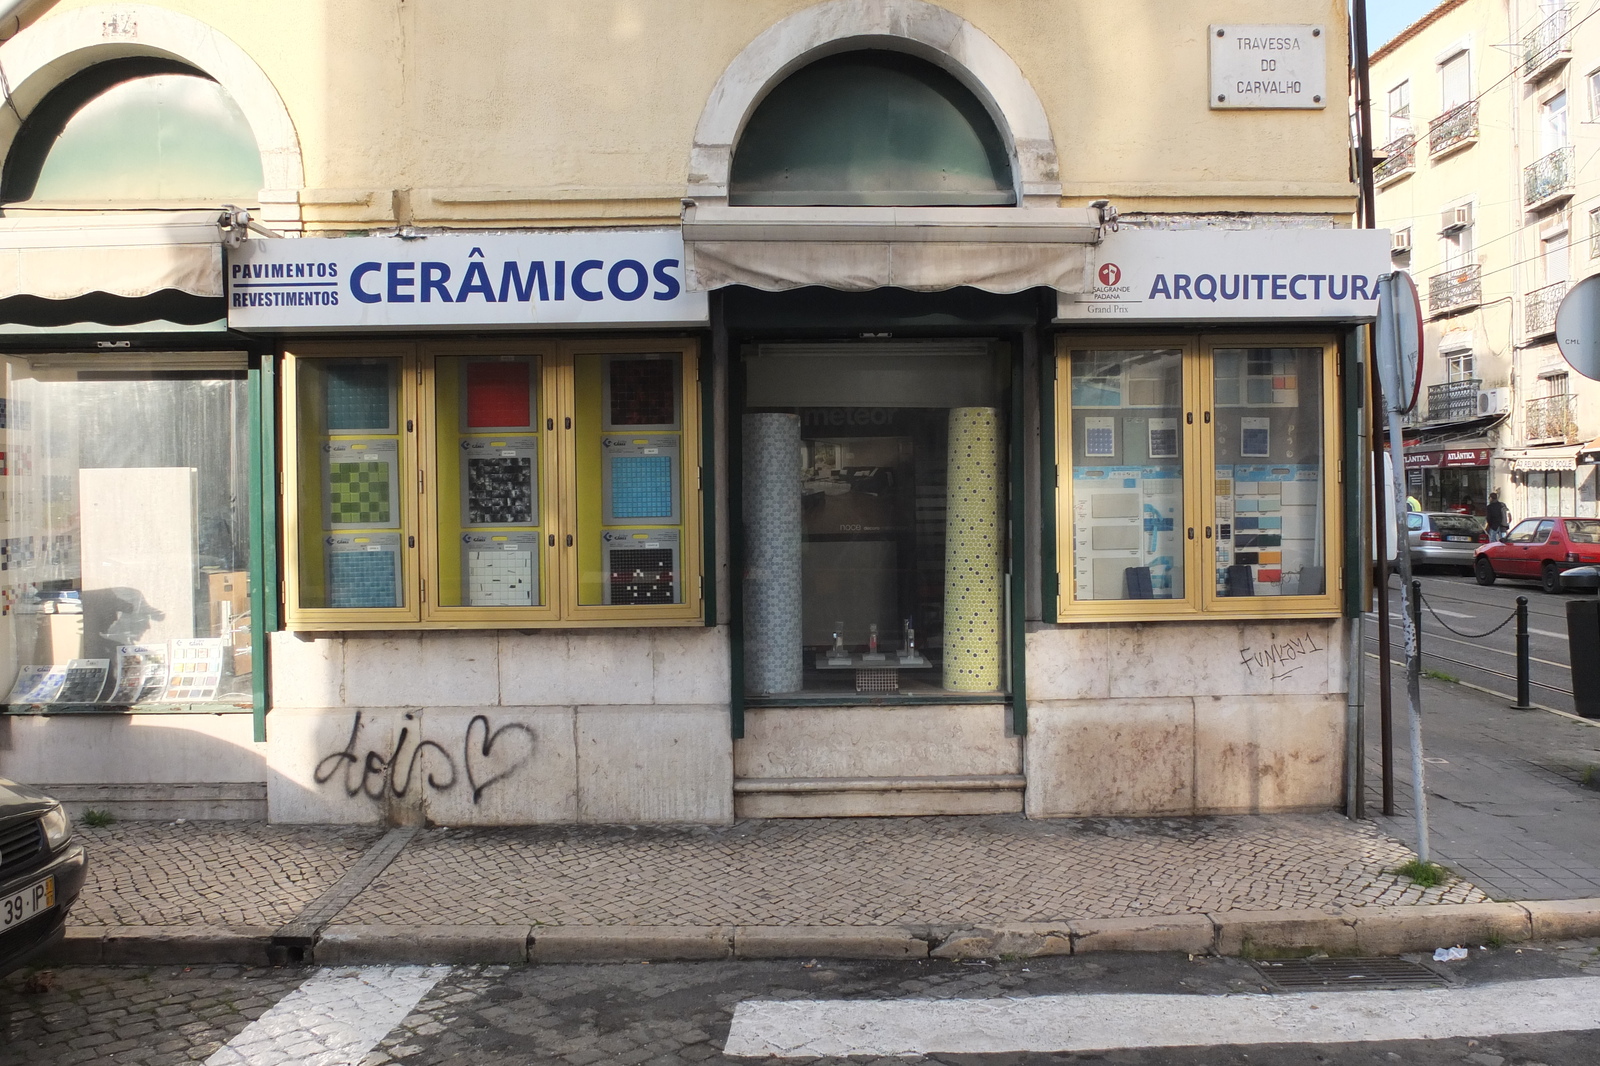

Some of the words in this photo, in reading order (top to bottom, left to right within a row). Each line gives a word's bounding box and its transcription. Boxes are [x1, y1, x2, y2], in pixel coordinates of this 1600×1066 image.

[1237, 37, 1301, 50] TRAVESSA
[1261, 59, 1276, 72] DO
[1236, 81, 1301, 94] CARVALHO
[232, 262, 338, 279] PAVIMENTOS
[349, 247, 681, 303] CERÂMICOS
[232, 290, 339, 307] REVESTIMENTOS
[1087, 304, 1112, 313] Grand
[1114, 304, 1129, 313] Prix
[804, 407, 898, 426] meteor
[1403, 454, 1430, 463] TLÂNTICA
